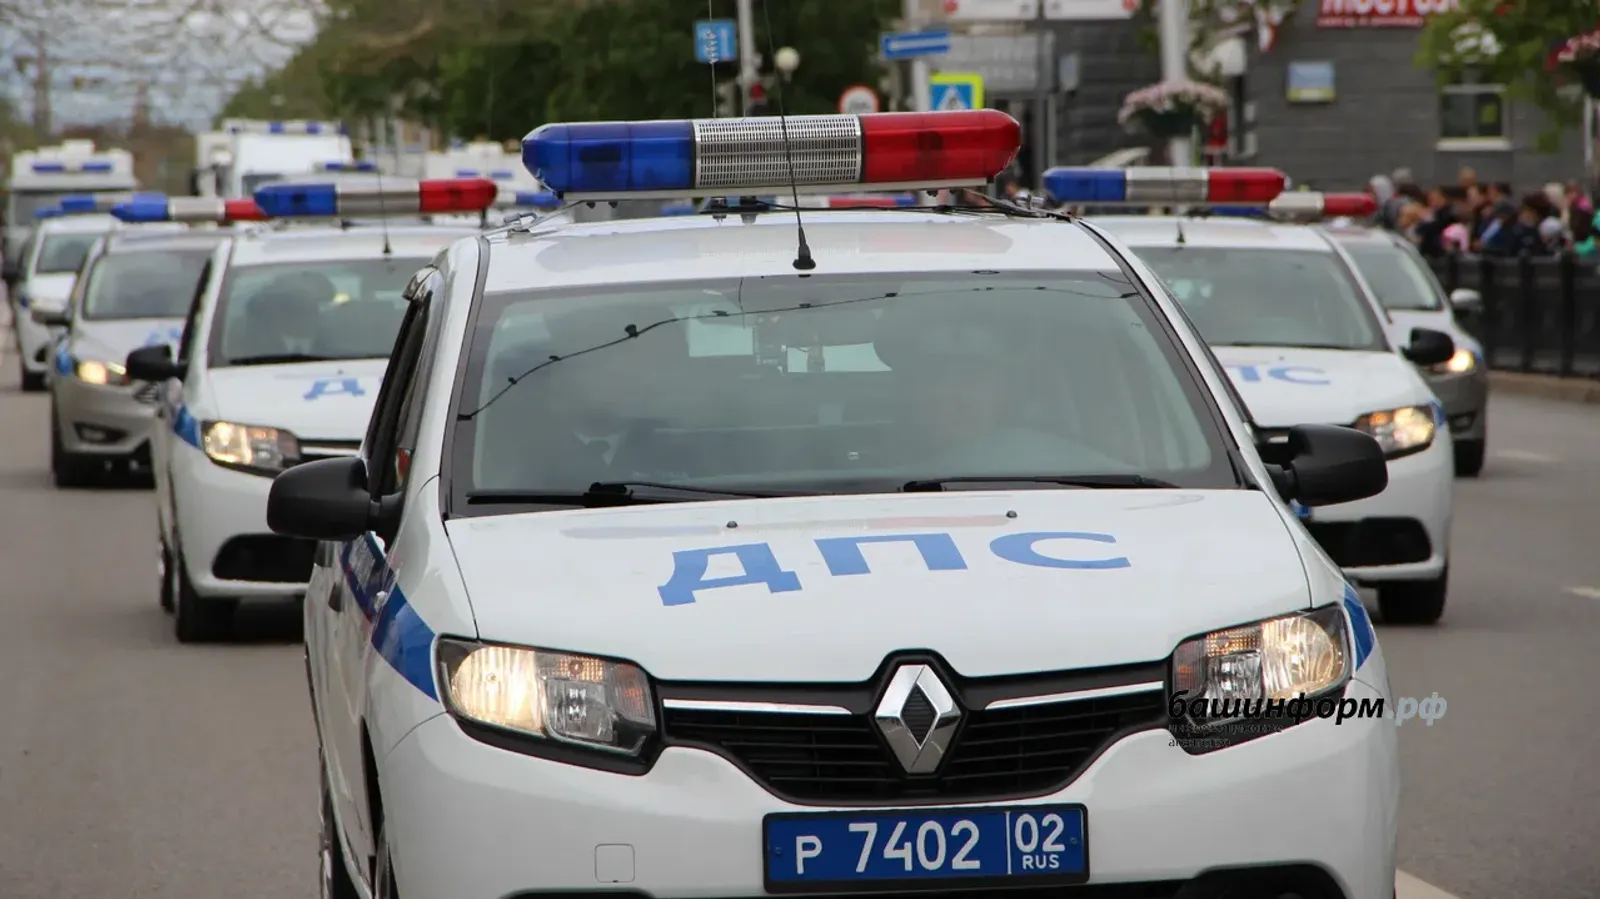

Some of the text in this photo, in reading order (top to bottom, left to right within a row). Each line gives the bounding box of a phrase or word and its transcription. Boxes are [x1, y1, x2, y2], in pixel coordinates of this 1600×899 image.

[657, 531, 1132, 606] ДПС
[848, 820, 981, 874] 7402
[1014, 813, 1066, 853] 02
[1022, 854, 1060, 870] RUS
